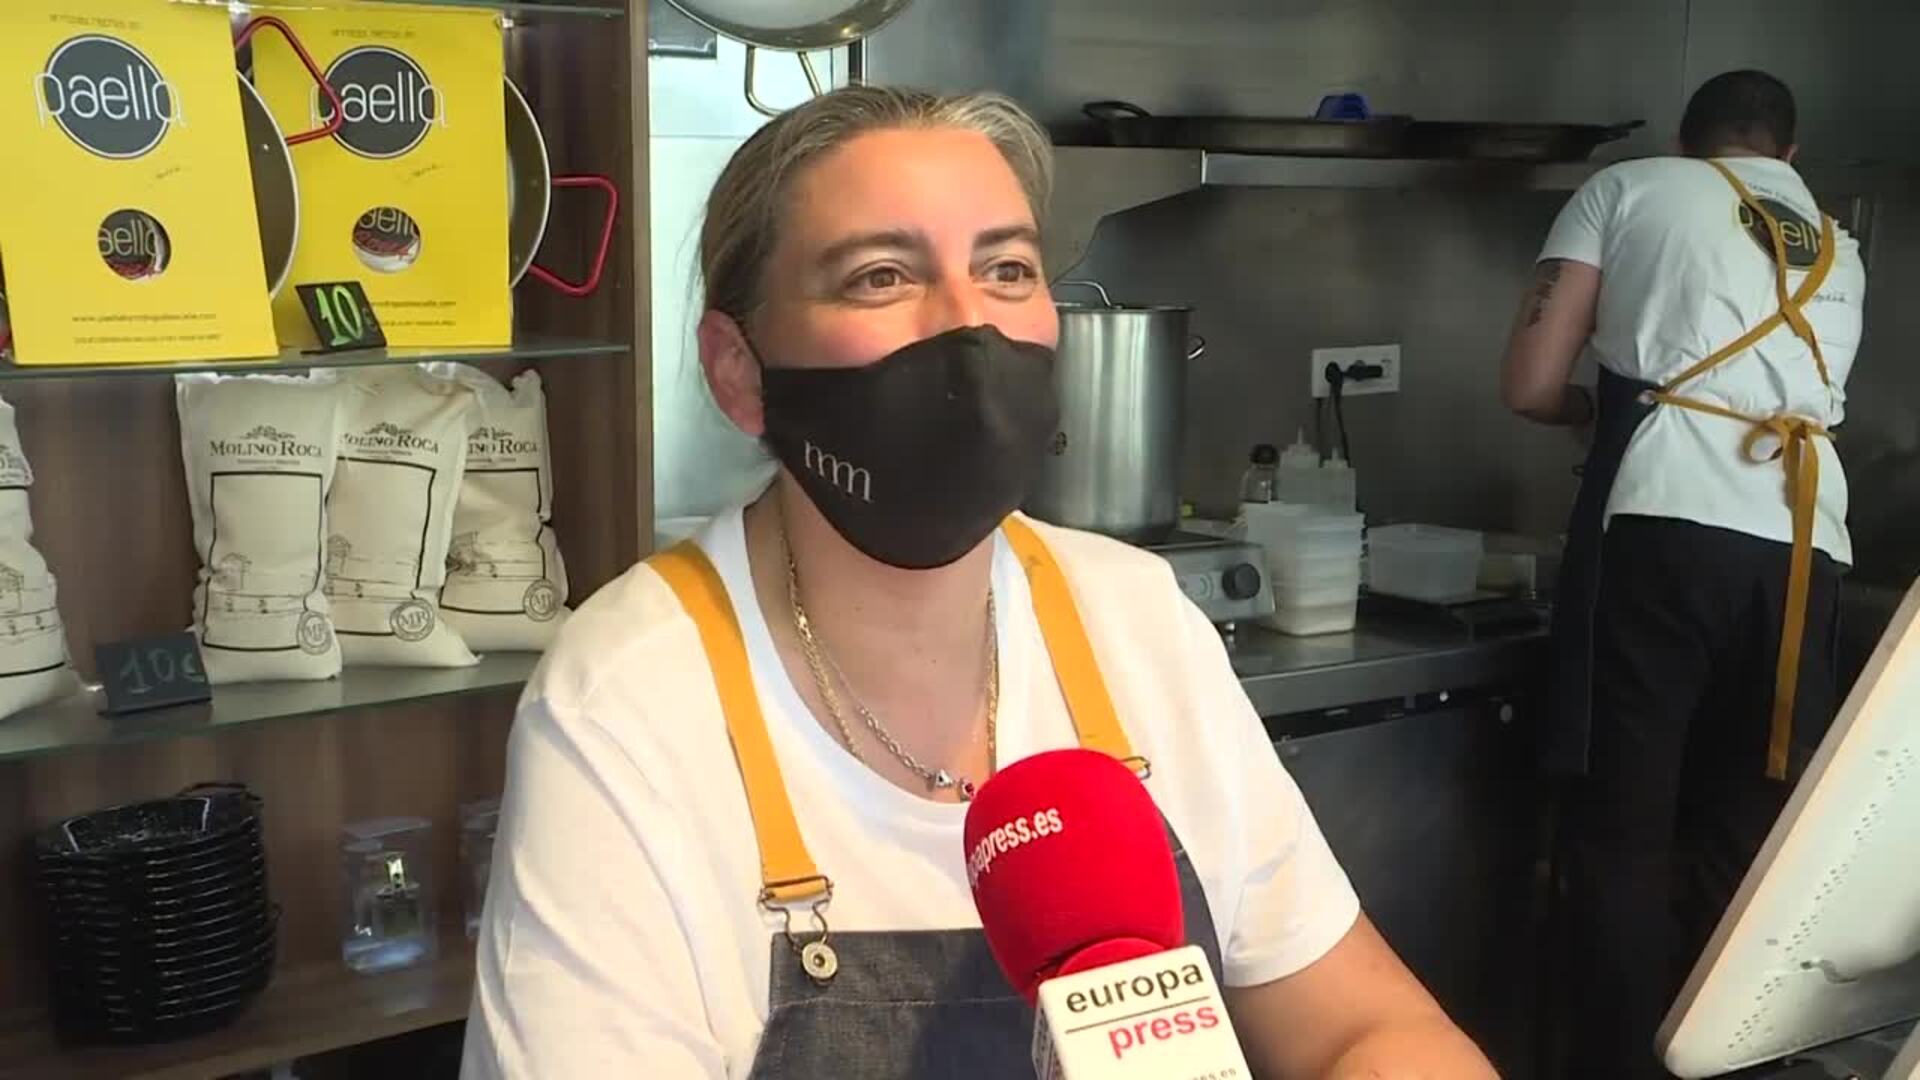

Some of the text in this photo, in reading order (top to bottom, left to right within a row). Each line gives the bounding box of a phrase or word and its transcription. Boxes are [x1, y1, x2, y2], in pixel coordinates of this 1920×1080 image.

[35, 64, 187, 128] paella
[209, 440, 278, 456] MOLINO
[1066, 963, 1204, 1013] europa
[1108, 1005, 1220, 1060] press
